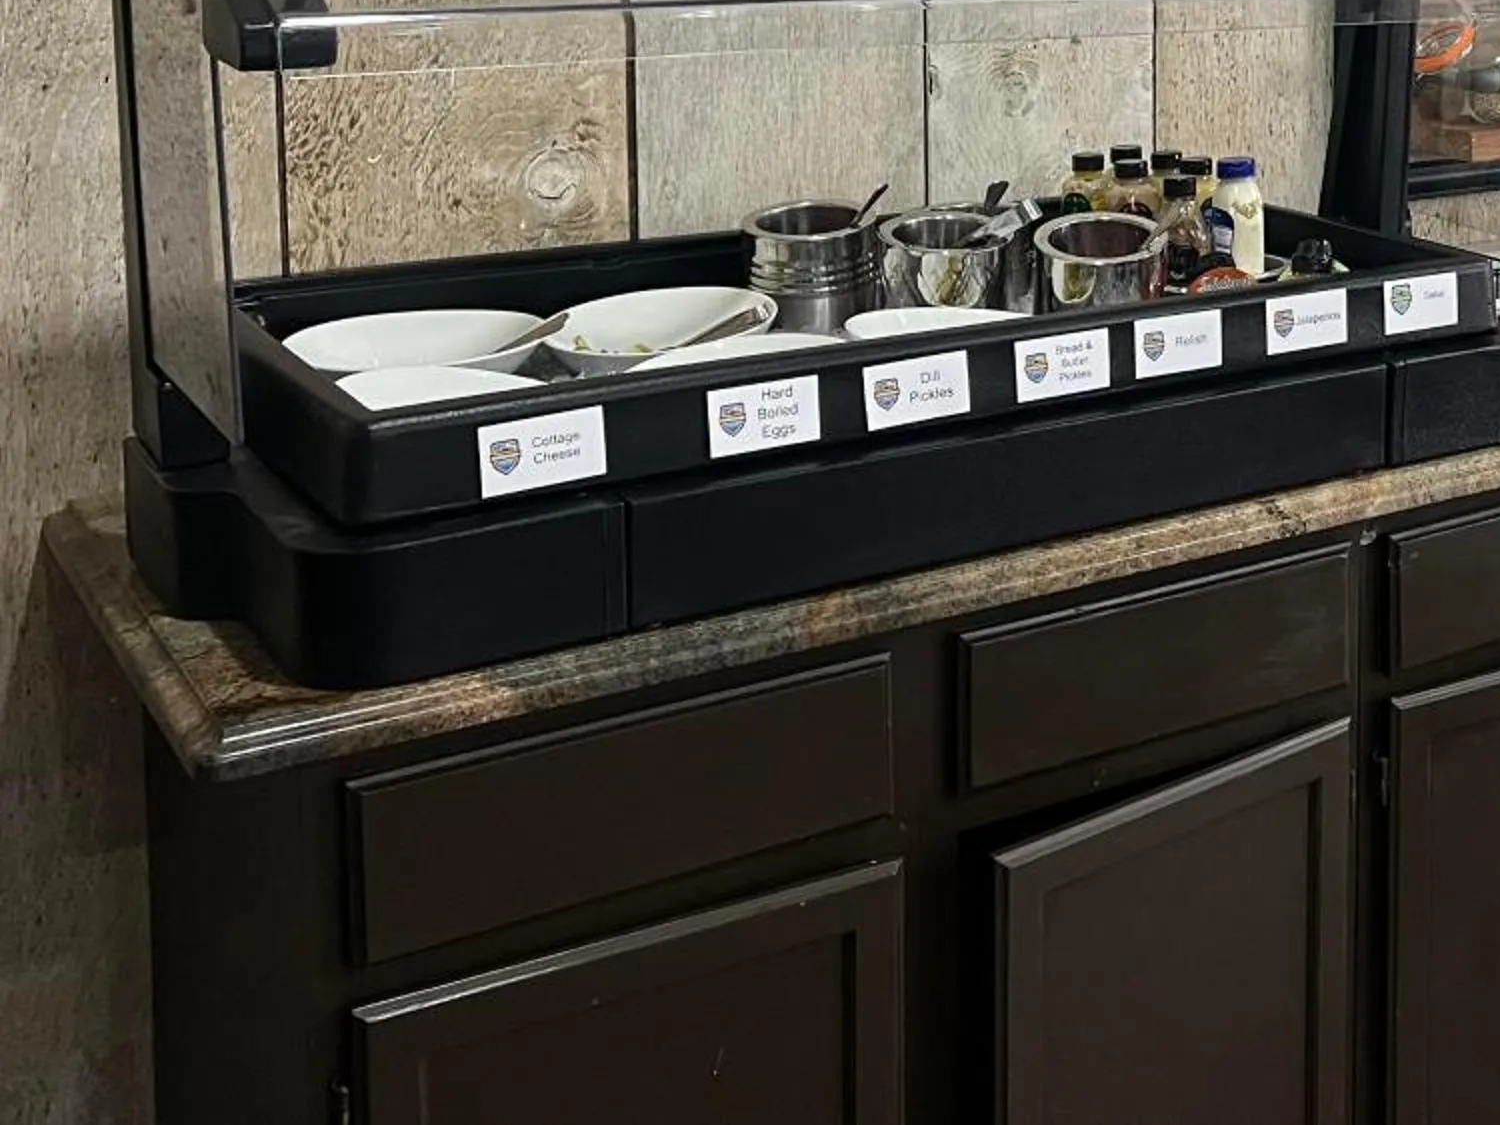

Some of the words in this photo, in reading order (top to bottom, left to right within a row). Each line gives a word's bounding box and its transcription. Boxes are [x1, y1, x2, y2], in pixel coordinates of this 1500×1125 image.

[761, 384, 793, 401] Hard
[909, 387, 954, 403] Pickles
[762, 424, 796, 439] Eggs
[531, 432, 581, 449] Cottage
[533, 448, 581, 464] Cheese
